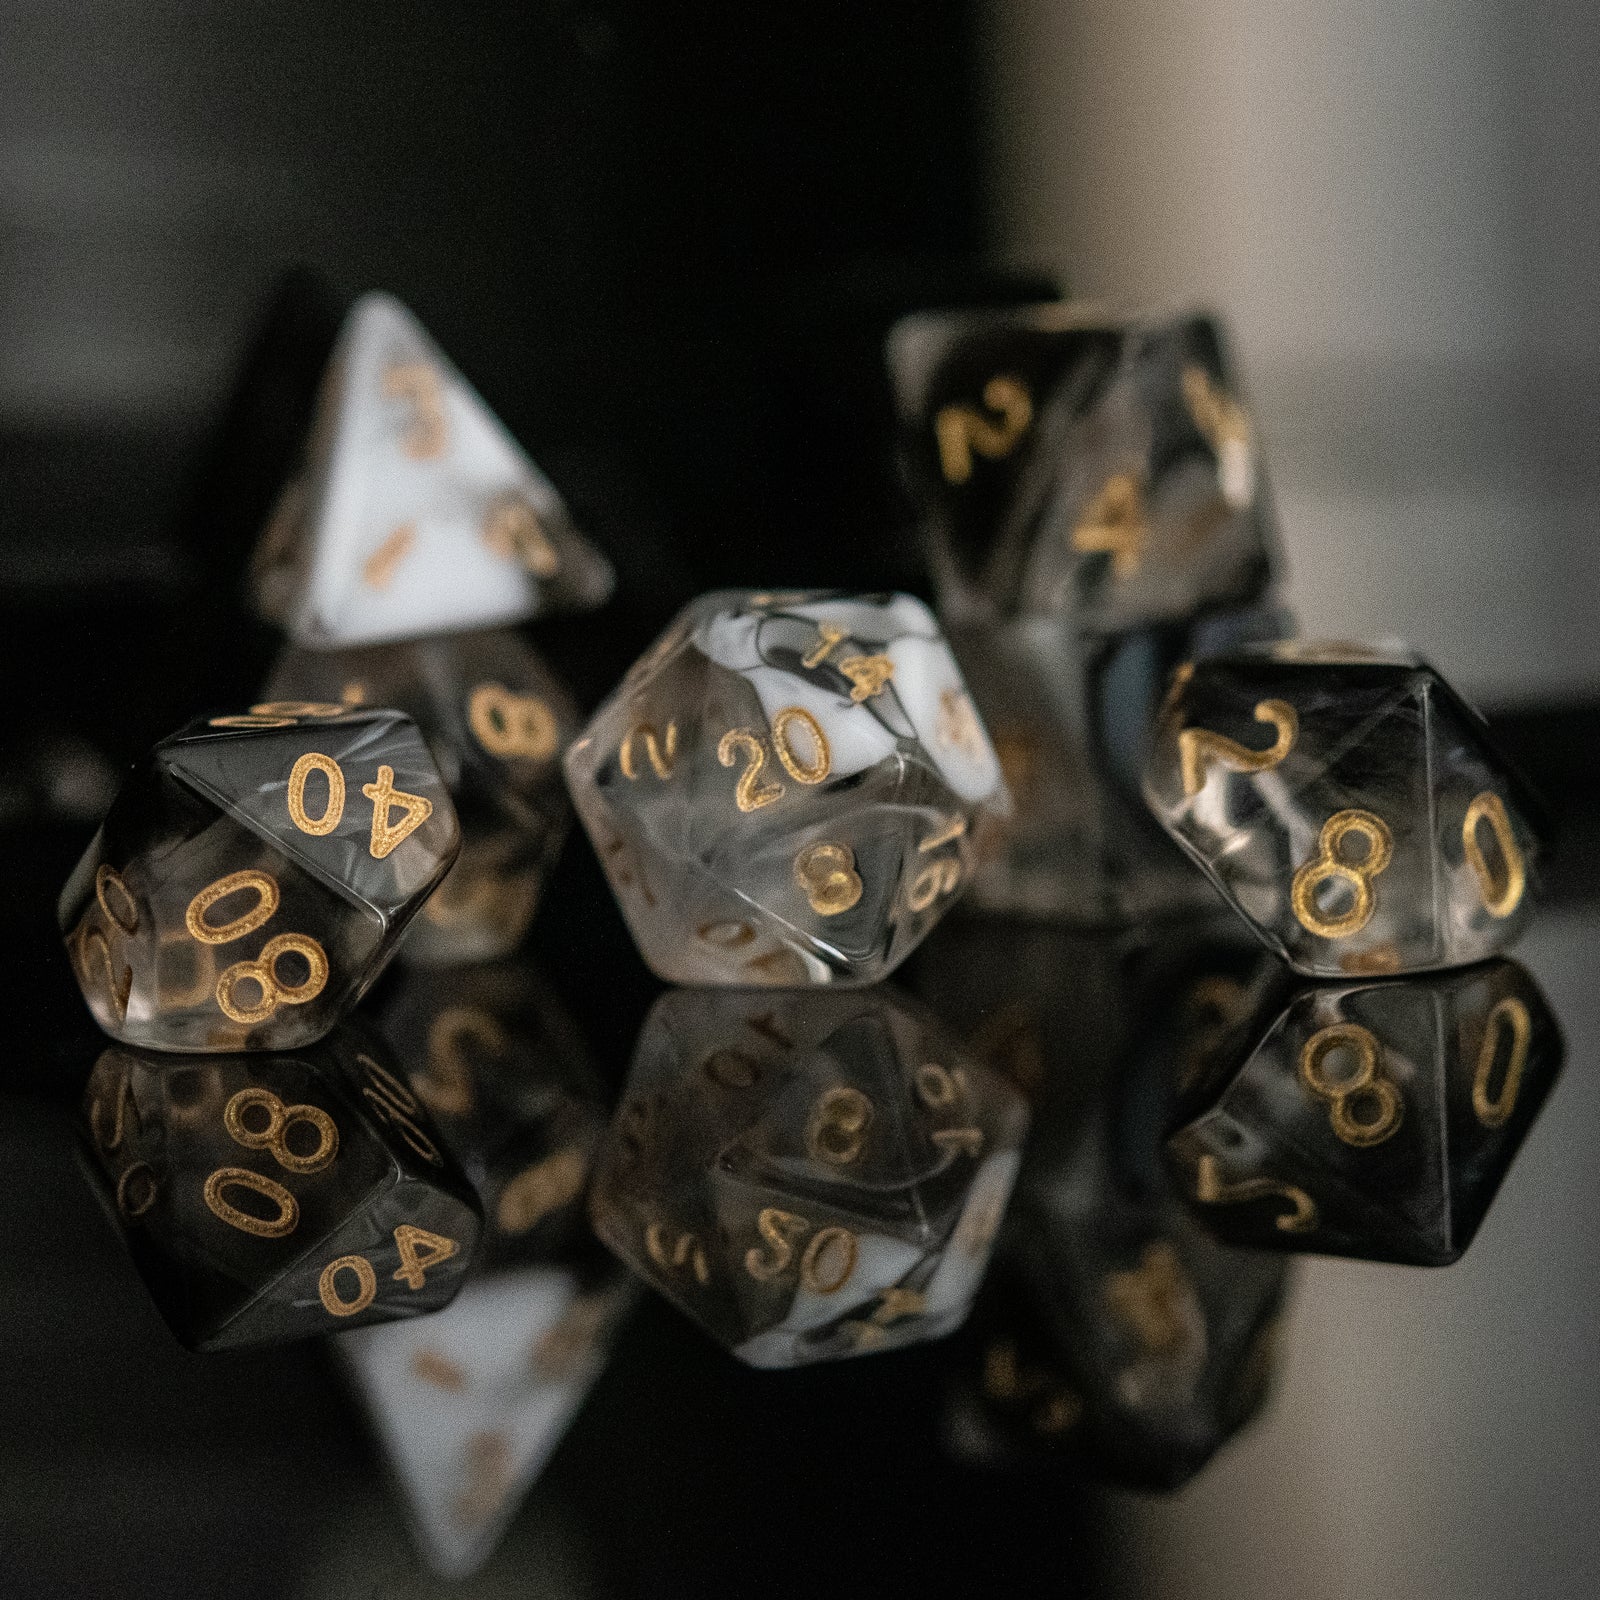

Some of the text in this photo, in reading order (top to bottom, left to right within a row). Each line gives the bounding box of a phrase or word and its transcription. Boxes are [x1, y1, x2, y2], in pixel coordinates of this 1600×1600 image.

[719, 706, 832, 812] 20
[1179, 699, 1298, 795] 2
[287, 752, 434, 859] 40
[1463, 791, 1524, 918] 0
[796, 843, 863, 916] 8
[1292, 809, 1392, 938] 8
[185, 868, 330, 1024] 80
